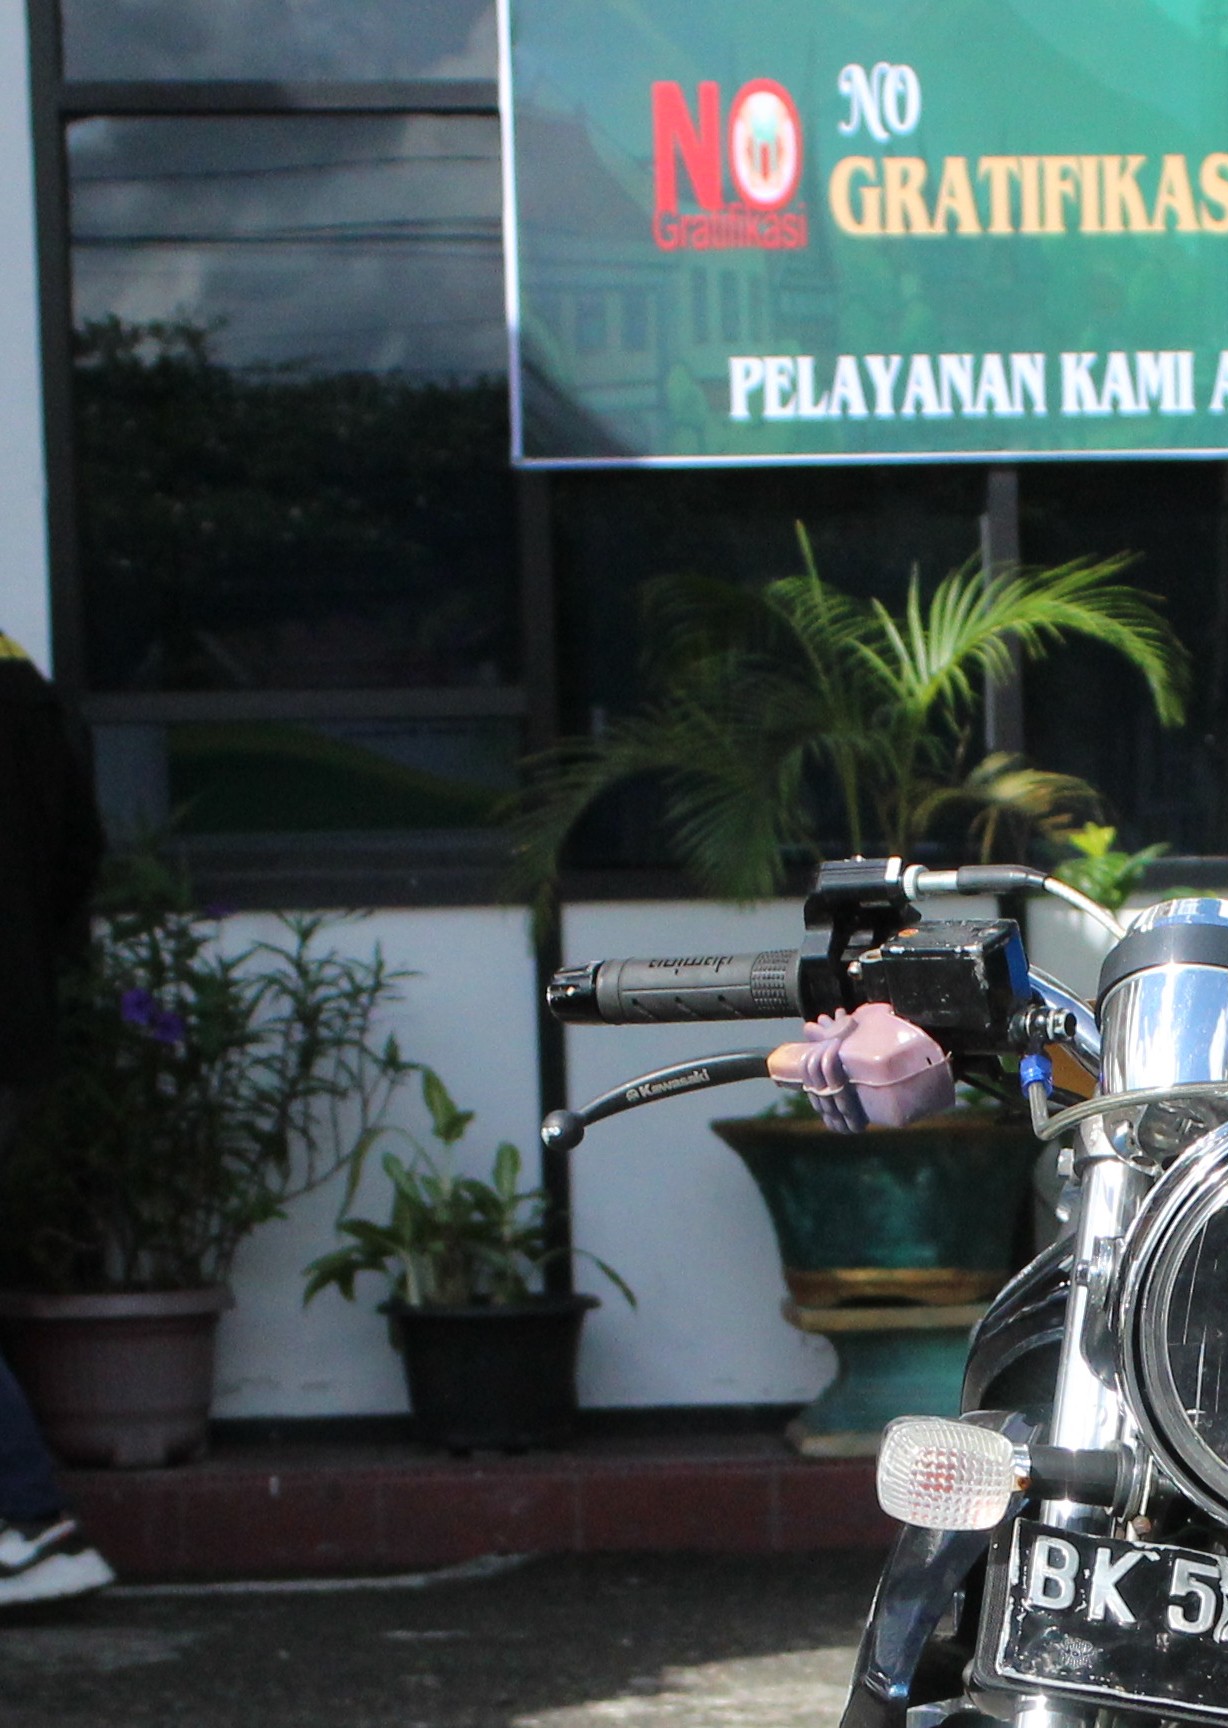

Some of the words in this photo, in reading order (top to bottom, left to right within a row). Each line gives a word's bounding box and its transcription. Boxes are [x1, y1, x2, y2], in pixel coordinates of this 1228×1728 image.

[837, 62, 922, 141] NO
[729, 354, 1046, 419] PELAYANAN
[1058, 351, 1195, 416] KAMI
[638, 1068, 711, 1098] Kawasaki
[1028, 1535, 1139, 1627] BK
